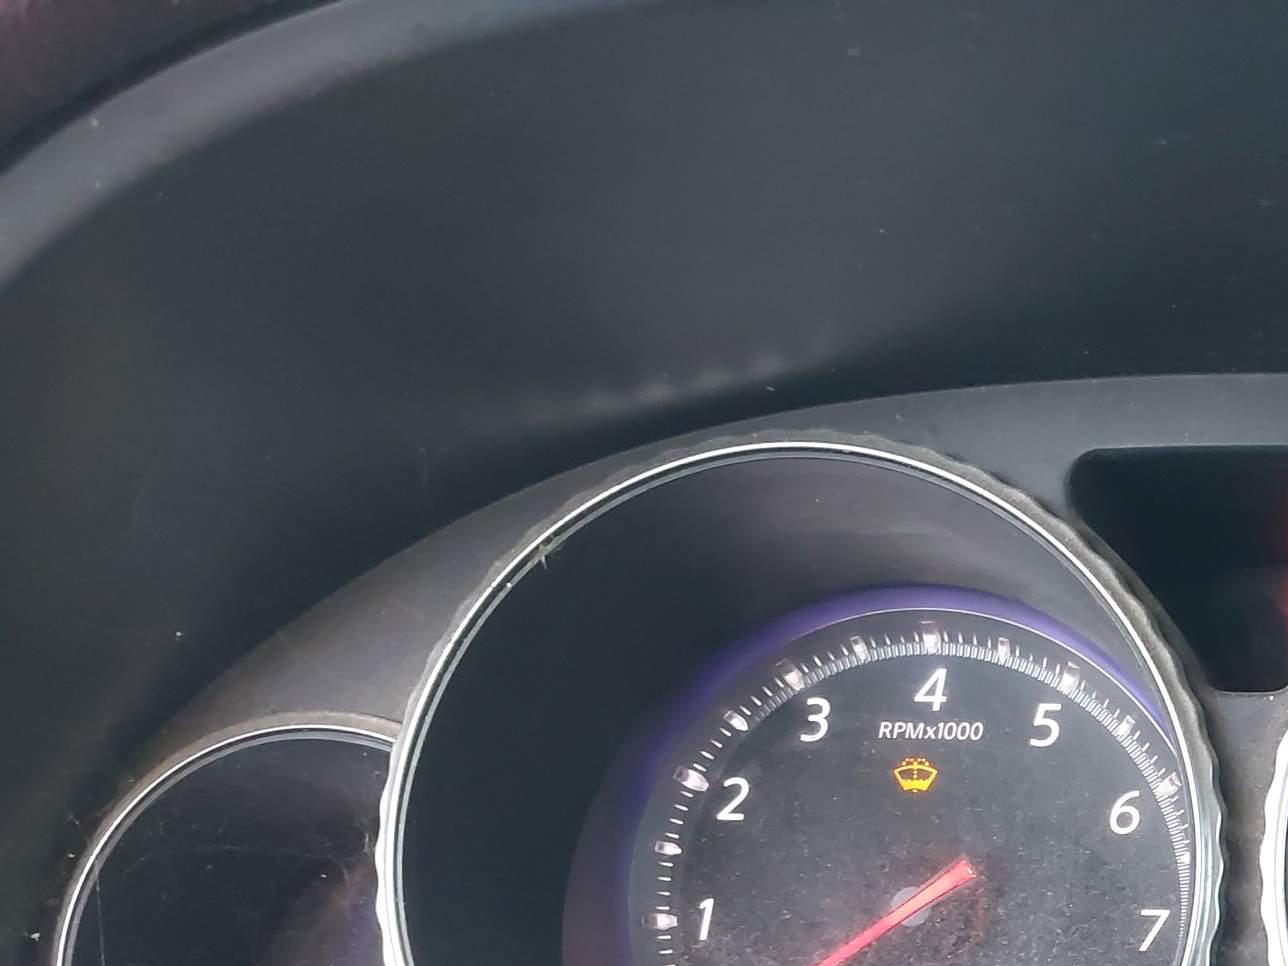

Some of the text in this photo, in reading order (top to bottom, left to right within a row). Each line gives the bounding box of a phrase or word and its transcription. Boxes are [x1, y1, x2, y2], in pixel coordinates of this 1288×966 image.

[914, 669, 947, 711] 4
[800, 697, 830, 742] 3
[878, 722, 984, 742] RPMx1000
[1030, 703, 1062, 747] 5
[717, 777, 751, 821] 2
[1109, 790, 1141, 835] 6
[699, 898, 715, 941] 1
[1138, 909, 1170, 952] 7
